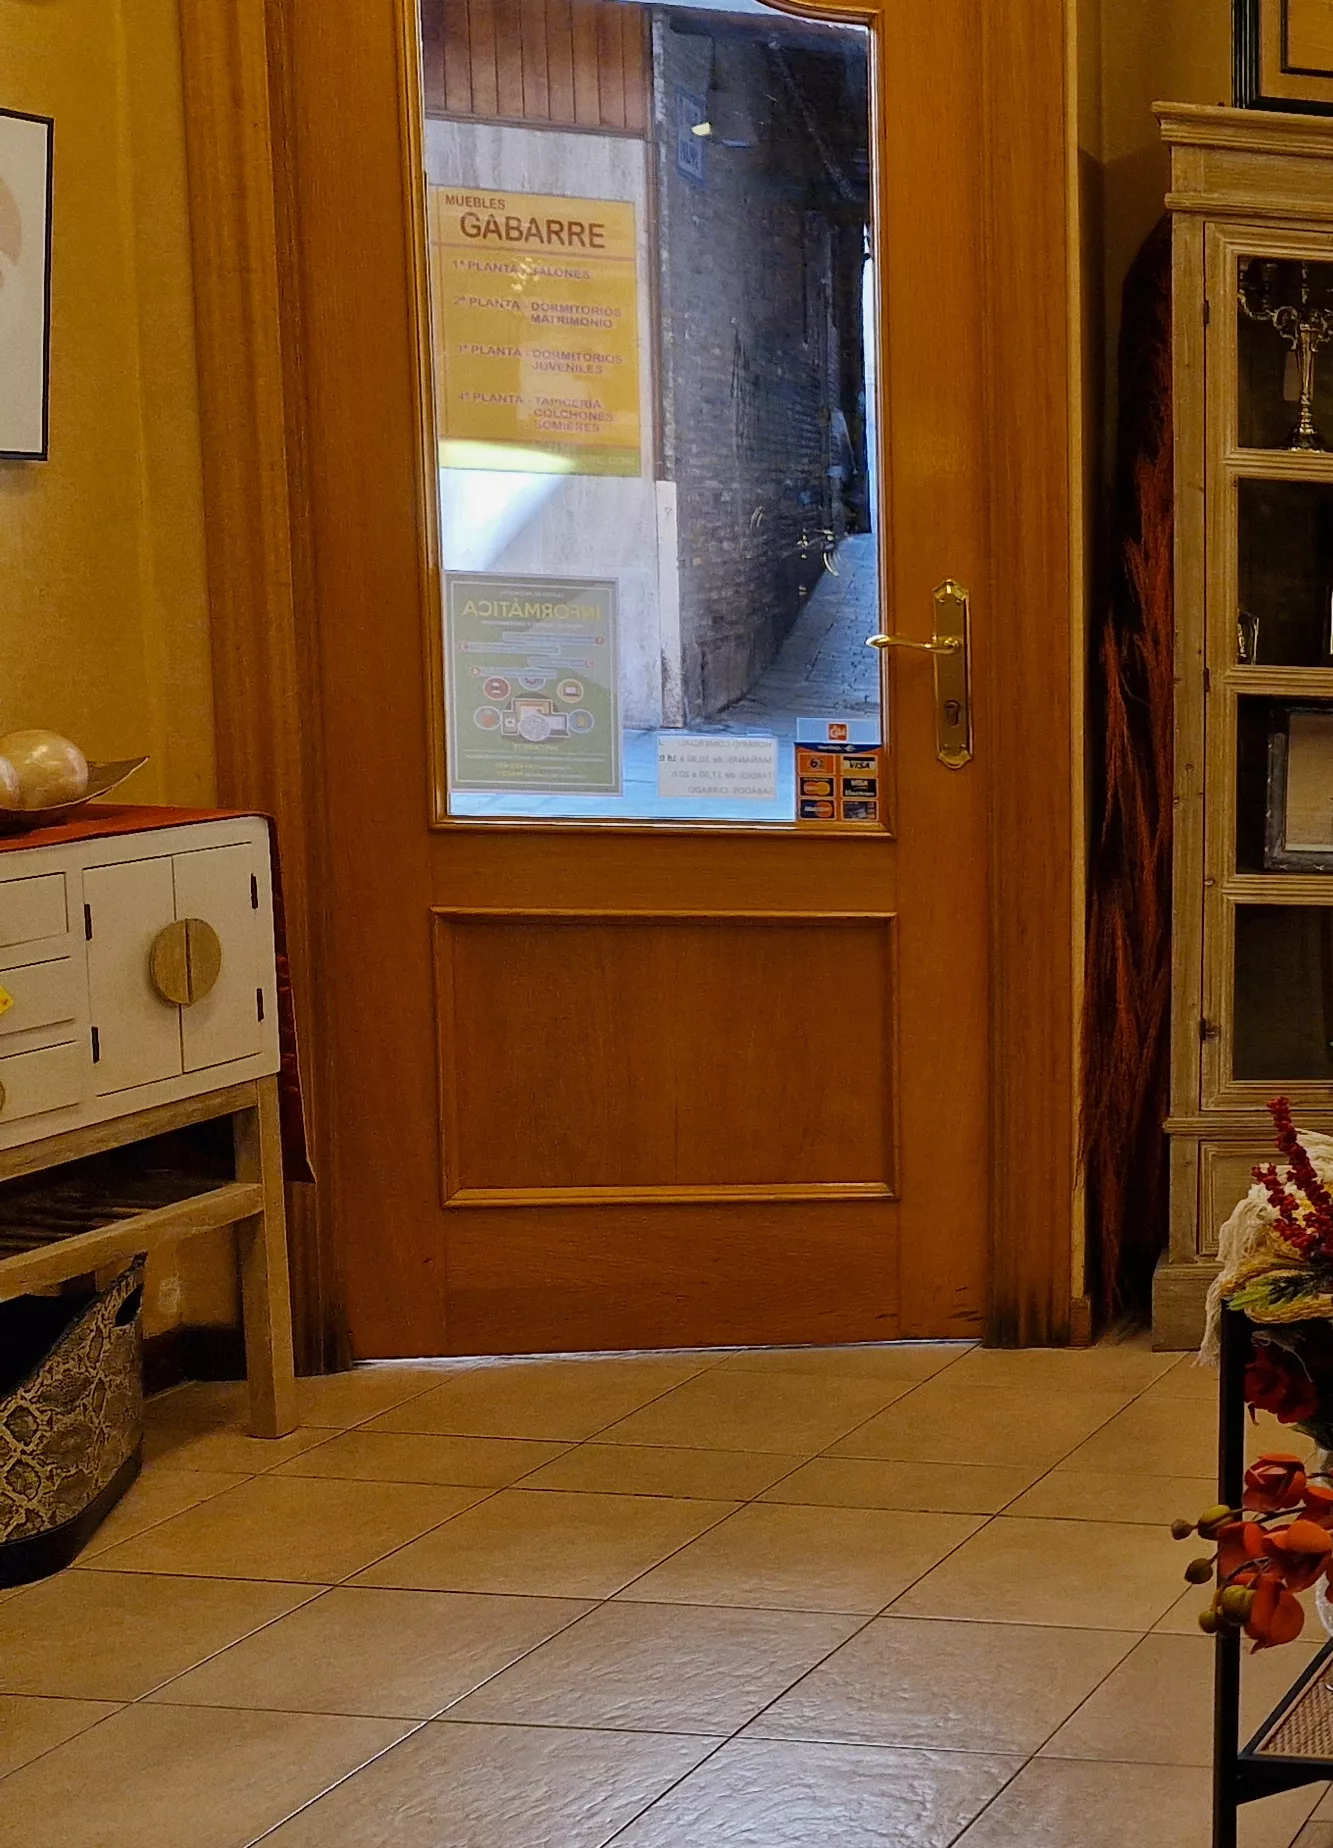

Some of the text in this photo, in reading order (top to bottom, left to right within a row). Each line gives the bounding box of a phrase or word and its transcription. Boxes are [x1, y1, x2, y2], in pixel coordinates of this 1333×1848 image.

[445, 194, 506, 211] MUEBLES
[459, 211, 606, 249] GABARRE
[468, 261, 519, 273] PLANTA
[469, 298, 521, 311] PLANTA
[530, 301, 622, 317] DORMITORIOS
[471, 344, 522, 358] PLANTA
[532, 349, 623, 364] DORMITORIOS
[531, 362, 604, 374] JUVENILES
[473, 392, 524, 405] PLANTA
[533, 408, 614, 422] COLCHONES
